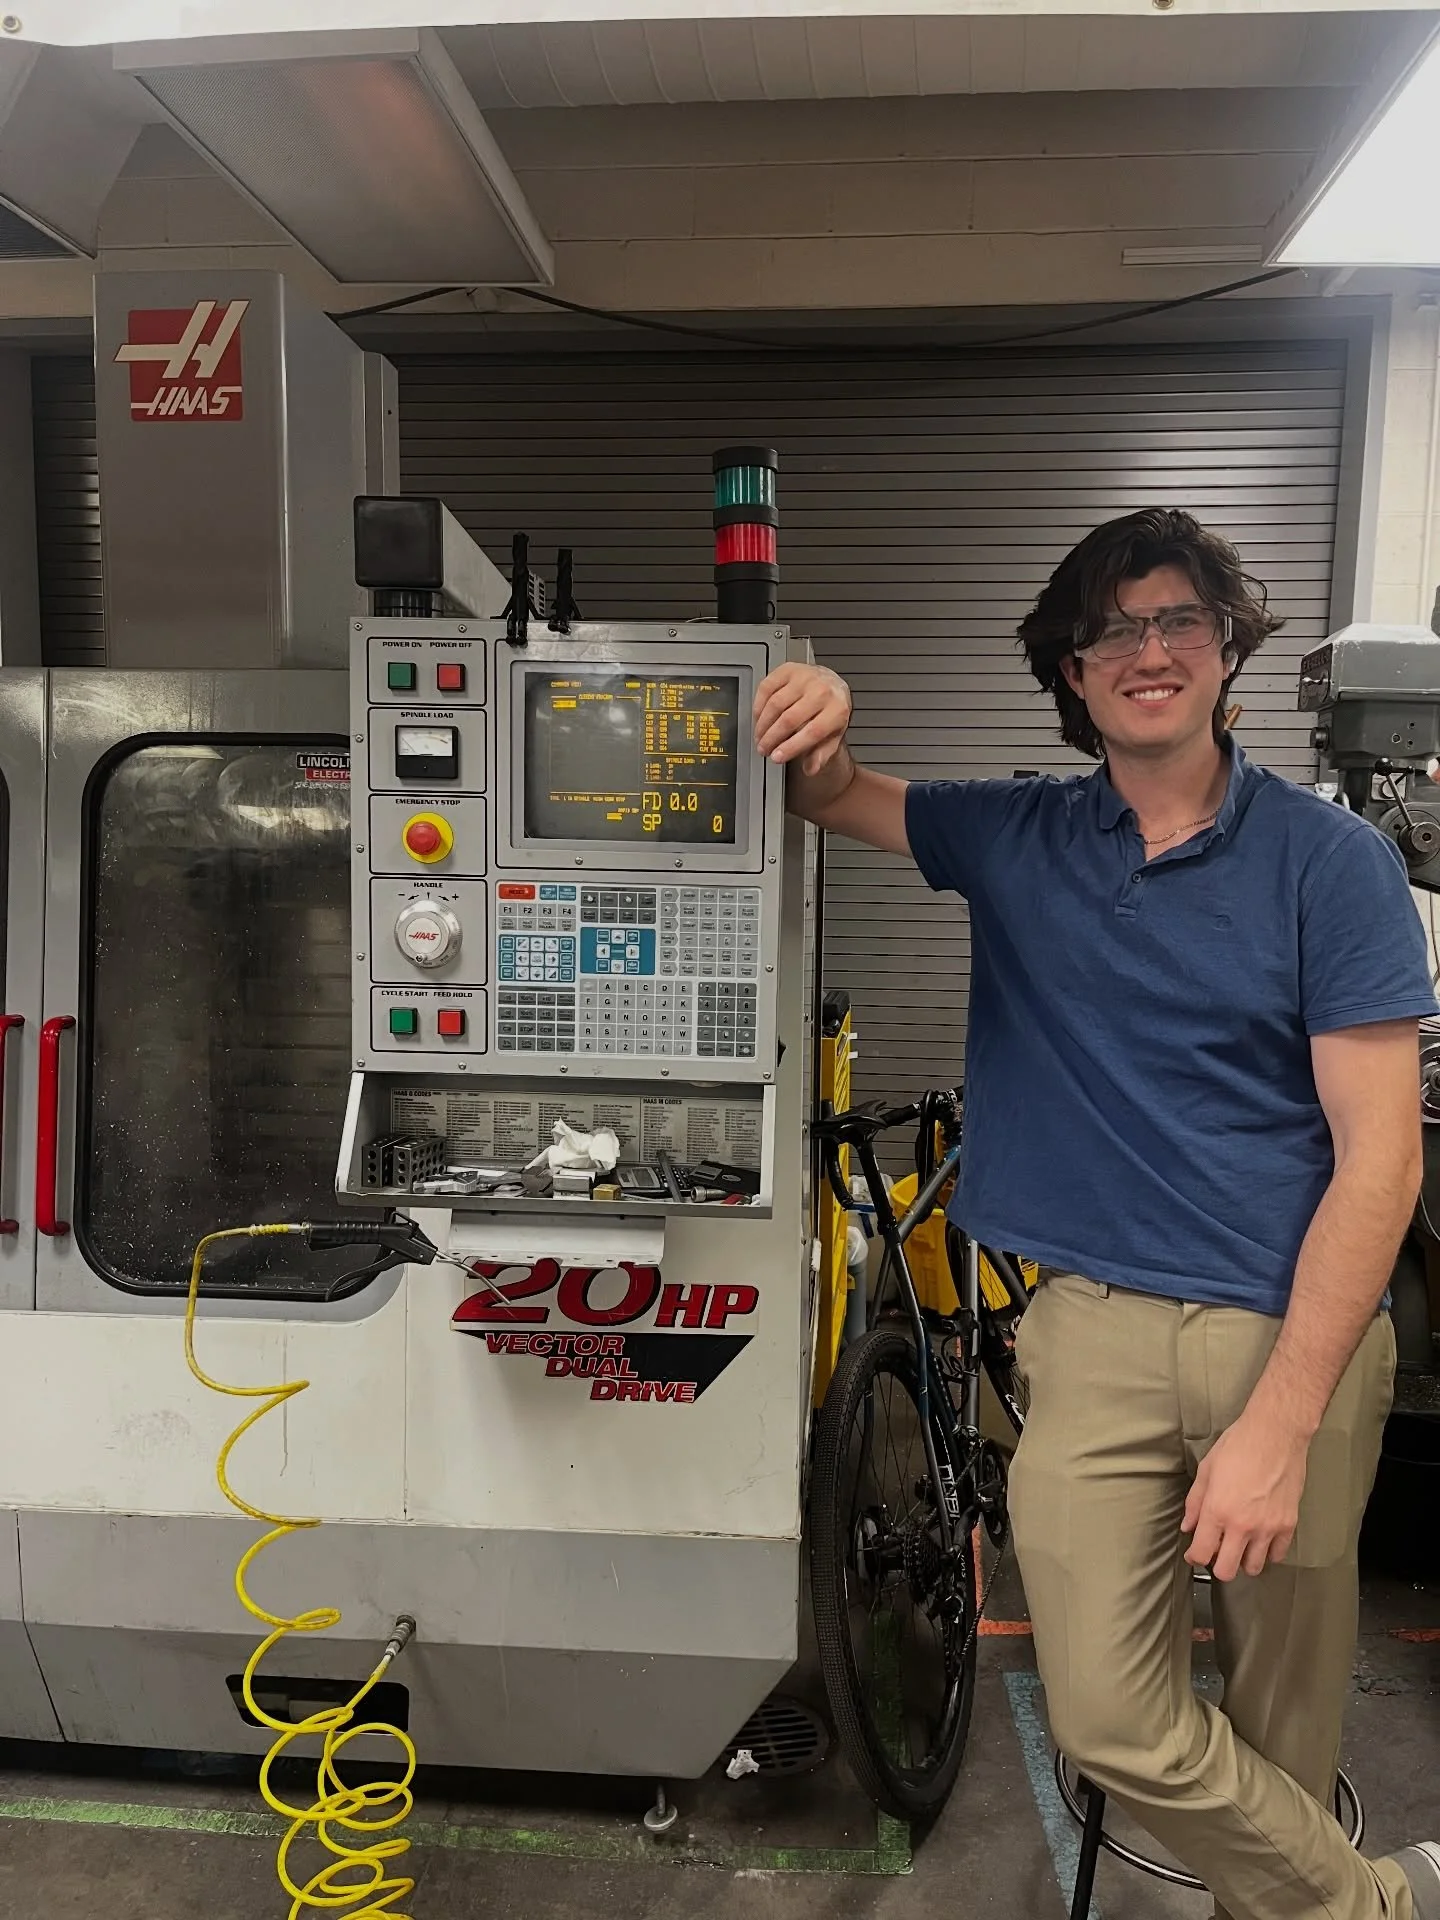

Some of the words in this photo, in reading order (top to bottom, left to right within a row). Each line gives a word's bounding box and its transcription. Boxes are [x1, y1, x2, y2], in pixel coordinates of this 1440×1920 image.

[131, 386, 242, 416] HAAS
[642, 792, 662, 810] FD
[670, 792, 698, 811] 0.0
[642, 813, 662, 831] SP
[713, 815, 723, 832] 0
[408, 932, 439, 940] HAAS
[452, 1258, 662, 1326] 20
[654, 1284, 760, 1328] HP
[485, 1332, 626, 1355] VECTOR
[545, 1357, 639, 1378] DUAL
[590, 1378, 698, 1404] DRIVE
